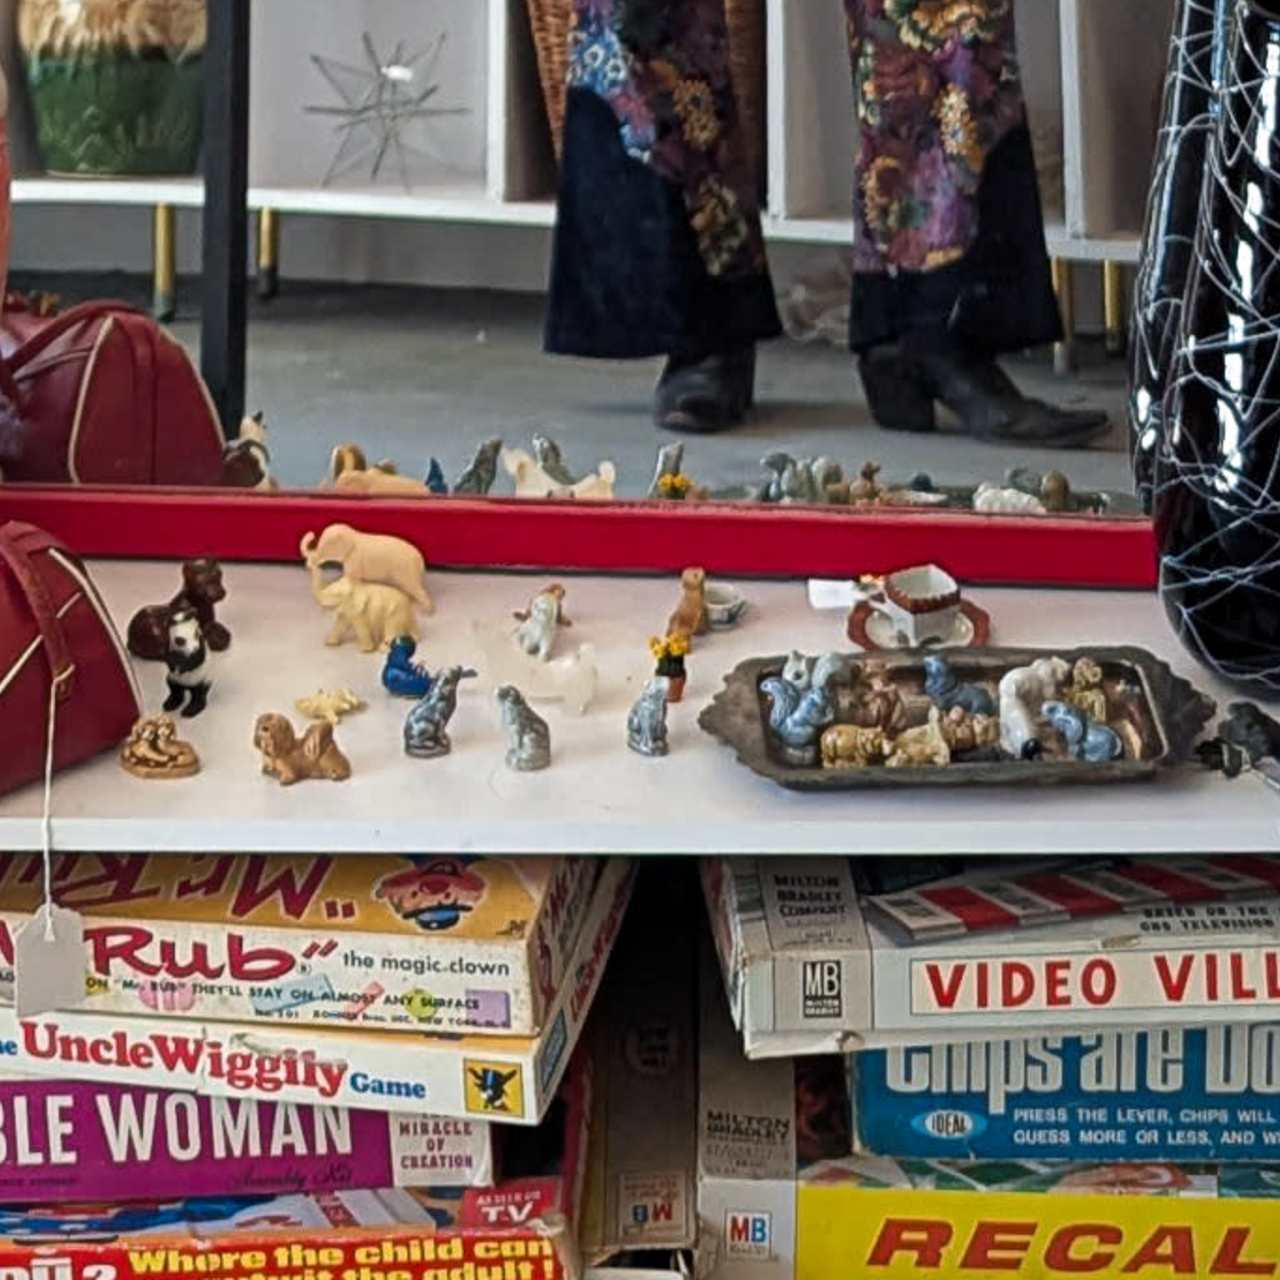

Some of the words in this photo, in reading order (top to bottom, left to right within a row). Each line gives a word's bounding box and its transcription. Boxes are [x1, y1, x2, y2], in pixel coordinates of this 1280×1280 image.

[773, 874, 840, 888] MILTON
[777, 888, 842, 902] BRADLEY
[1144, 906, 1195, 919] BASED
[1206, 905, 1227, 917] ON
[1238, 905, 1269, 916] THE
[1182, 918, 1274, 931] TELEVISION
[343, 950, 374, 969] the
[382, 956, 442, 977] magic
[448, 958, 510, 976] clown
[804, 961, 841, 997] MB
[925, 958, 1117, 1009] VIDEO
[86, 976, 108, 989] ON
[191, 981, 243, 997] THEY'LL
[249, 985, 284, 1000] STAY
[290, 988, 315, 1001] ON
[320, 990, 377, 1006] ALMOST
[383, 994, 414, 1007] ANY
[420, 996, 481, 1011] SURFACE
[20, 1022, 152, 1068] Uncle
[350, 1074, 426, 1099] Game
[1080, 1026, 1184, 1094] are
[94, 1091, 352, 1162] WOMAN
[706, 1109, 791, 1130] MILTON
[930, 1112, 968, 1135] IDEAL
[1013, 1108, 1069, 1125] PRESS
[1077, 1108, 1108, 1124] THE
[1117, 1108, 1174, 1126] LEVER,
[1180, 1108, 1230, 1124] CHIPS
[1237, 1108, 1276, 1124] WILL
[398, 1121, 472, 1137] MIRACLE
[1013, 1129, 1070, 1145] GUESS
[1079, 1129, 1127, 1145] MORE
[1135, 1129, 1160, 1145] OR
[1166, 1129, 1215, 1146] LESS,
[1220, 1129, 1255, 1145] AND
[425, 1138, 445, 1152] OF
[400, 1154, 473, 1169] CREATION
[729, 1214, 768, 1244] MB
[127, 1248, 266, 1275] Where
[273, 1242, 345, 1268] the
[354, 1238, 464, 1265] child
[472, 1237, 554, 1260] can
